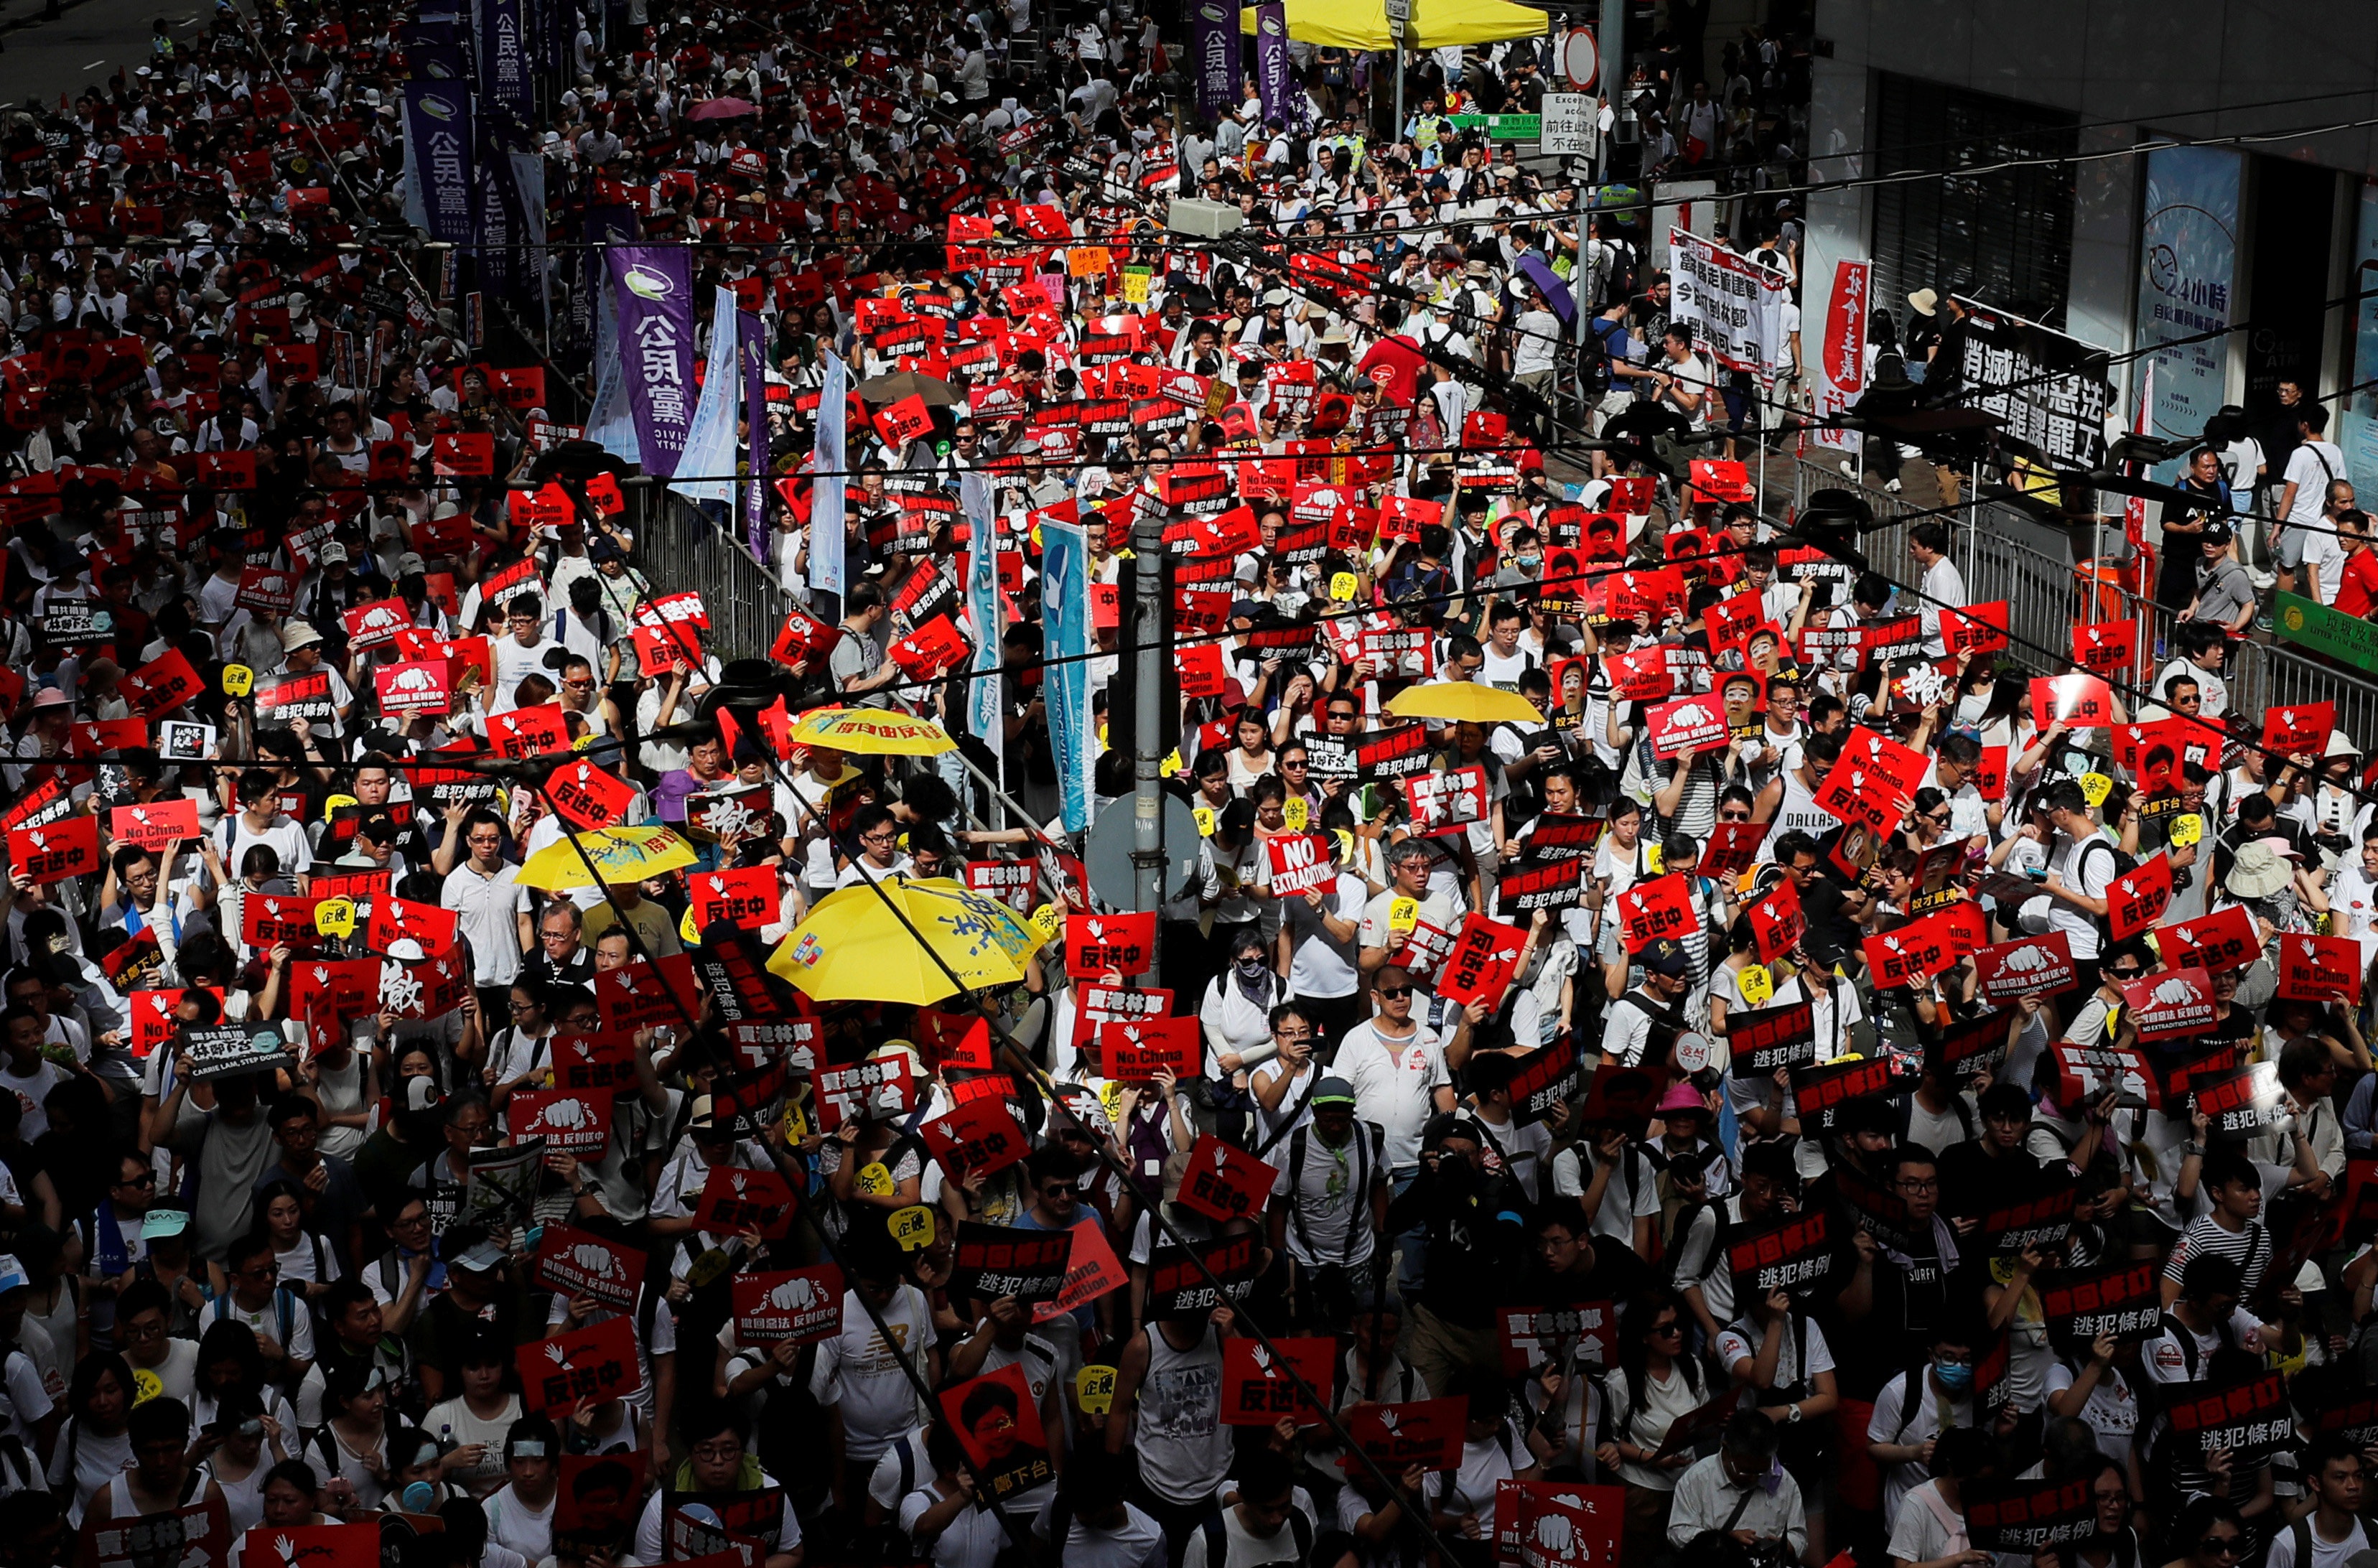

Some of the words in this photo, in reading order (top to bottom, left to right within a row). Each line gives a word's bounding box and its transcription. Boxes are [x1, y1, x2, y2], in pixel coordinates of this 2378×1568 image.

[1016, 295, 1045, 310] 反送中
[1113, 380, 1149, 397] 反送中
[887, 416, 924, 439] 反送中
[1246, 475, 1260, 485] No
[1261, 475, 1287, 485] China
[1701, 480, 1713, 489] No
[1714, 479, 1740, 488] China
[518, 507, 533, 517] No
[533, 505, 562, 515] China
[882, 536, 929, 556] 逃犯條例
[1208, 541, 1223, 552] No
[1223, 531, 1249, 546] China
[910, 577, 953, 620] 逃犯條例
[1615, 594, 1630, 606] No
[1631, 593, 1659, 607] China
[1363, 631, 1425, 650] 賣港林鄭
[1803, 630, 1863, 646] 賣港林鄭
[910, 661, 923, 673] No
[923, 642, 953, 662] China
[1259, 645, 1310, 660] 逃犯條例
[1872, 641, 1922, 661] 逃犯條例
[2084, 643, 2126, 667] 反送中
[274, 701, 332, 720] 逃犯條例
[2274, 733, 2289, 745] No
[2290, 731, 2320, 742] China
[1374, 750, 1430, 778] 逃犯條例
[432, 783, 495, 801] 逃犯條例
[1412, 773, 1478, 798] 賣港林鄭
[553, 783, 609, 823] 反送中
[2140, 795, 2181, 816] 林鄭下台
[1786, 811, 1835, 827] DALLAS
[126, 827, 144, 839] No
[146, 823, 185, 838] China
[26, 848, 84, 877] 反送中
[1282, 839, 1315, 870] NO
[974, 863, 1032, 886] 賣港林鄭
[1270, 862, 1337, 897] EXTRADITION
[707, 900, 767, 920] 反送中
[1631, 907, 1684, 941] 反送中
[1080, 943, 1141, 970] 反送中
[1882, 947, 1941, 978] 反送中
[2177, 935, 2245, 969] 反送中
[2029, 965, 2070, 985] 反對送中
[2043, 979, 2053, 988] TO
[2053, 975, 2071, 987] CHINA
[2290, 965, 2311, 981] No
[2313, 969, 2350, 986] China
[1086, 988, 1165, 1012] 賣港林鄭
[2177, 1004, 2212, 1019] 反對送中
[2196, 1015, 2214, 1025] CHINA
[143, 1023, 167, 1037] No
[192, 1063, 220, 1077] CARRIE
[241, 1054, 259, 1066] STEP
[1115, 1050, 1136, 1064] No
[1139, 1047, 1183, 1063] China
[1752, 1040, 1815, 1069] 逃犯條例
[2061, 1047, 2140, 1069] 賣港林鄭
[820, 1060, 902, 1093] 賣港林鄭
[2222, 1103, 2288, 1131] 逃犯條例
[564, 1131, 605, 1144] 反對送中
[1192, 1170, 1251, 1218] 反送中
[898, 1211, 927, 1238] 企硬
[1758, 1252, 1832, 1290] 逃犯條例
[976, 1271, 1062, 1294] 逃犯條例
[2073, 1306, 2160, 1337] 逃犯條例
[543, 1360, 624, 1408] 反送中
[1081, 1372, 1114, 1396] 企硬
[2200, 1417, 2293, 1452] 逃犯條例
